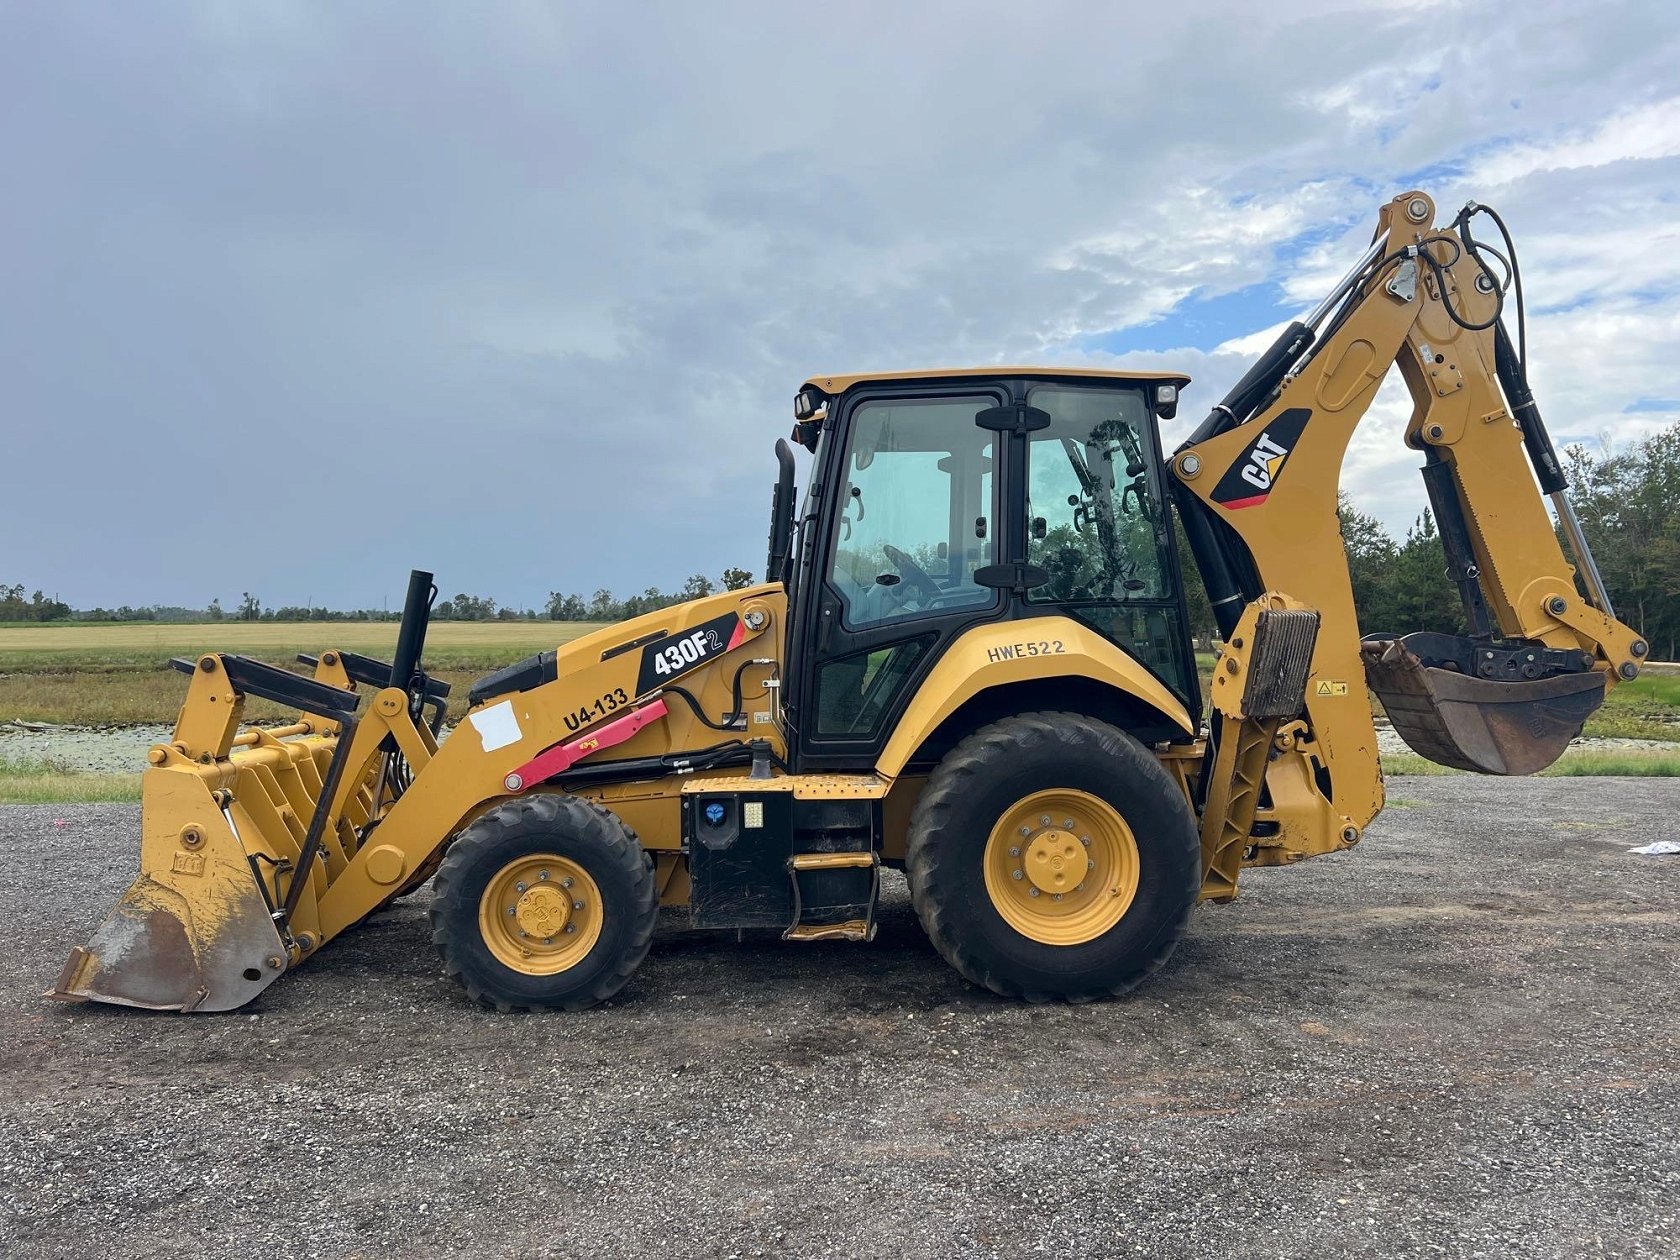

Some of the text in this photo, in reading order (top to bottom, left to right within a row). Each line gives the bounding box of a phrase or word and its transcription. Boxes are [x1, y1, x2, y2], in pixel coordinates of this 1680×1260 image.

[1241, 432, 1288, 490] CAT
[987, 640, 1066, 662] HWE522
[562, 687, 629, 731] U4-133
